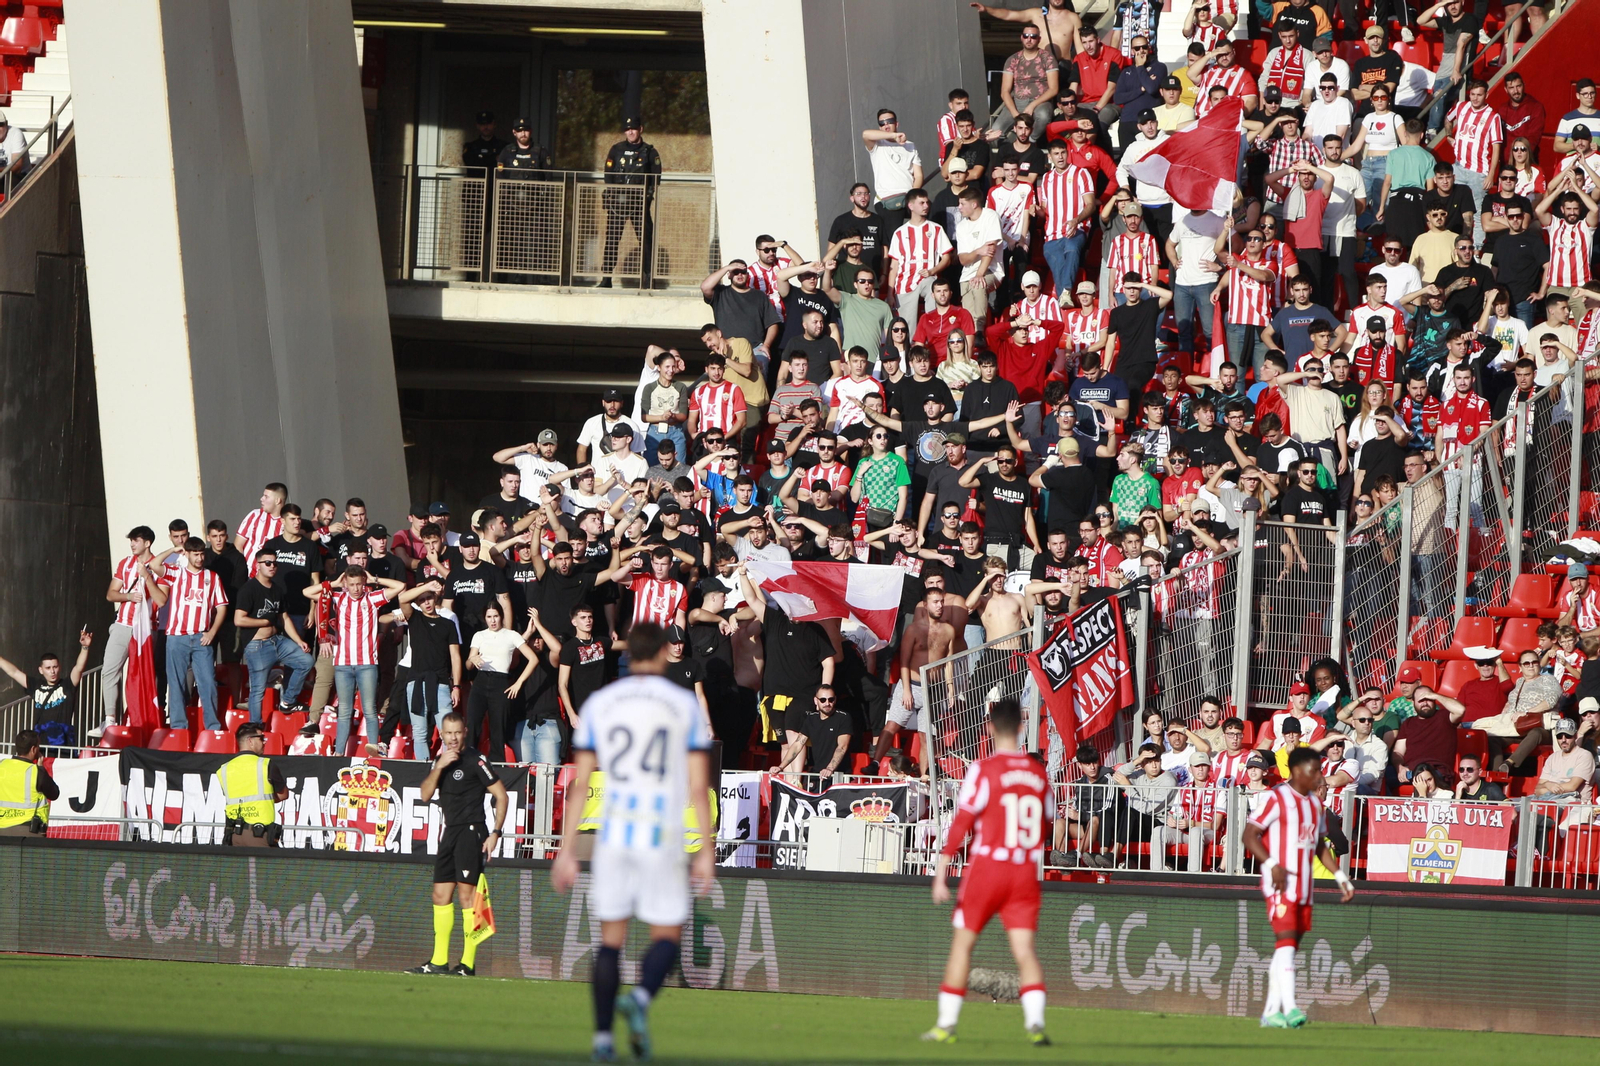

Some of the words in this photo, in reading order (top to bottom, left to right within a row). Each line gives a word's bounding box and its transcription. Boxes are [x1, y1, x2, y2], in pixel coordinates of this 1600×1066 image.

[1297, 18, 1310, 26] BOY
[993, 486, 1024, 500] ALMERIA
[609, 726, 669, 782] 24
[1000, 793, 1043, 849] 19
[1374, 802, 1428, 823] PEÑA
[1432, 805, 1459, 824] LA
[1464, 807, 1504, 828] UVA
[1416, 843, 1426, 853] U
[1445, 844, 1455, 855] D
[1413, 858, 1453, 869] ALMERIA
[103, 862, 140, 941] El
[145, 866, 235, 949] Corte
[1069, 903, 1113, 990] El
[1117, 910, 1222, 1000] Corte
